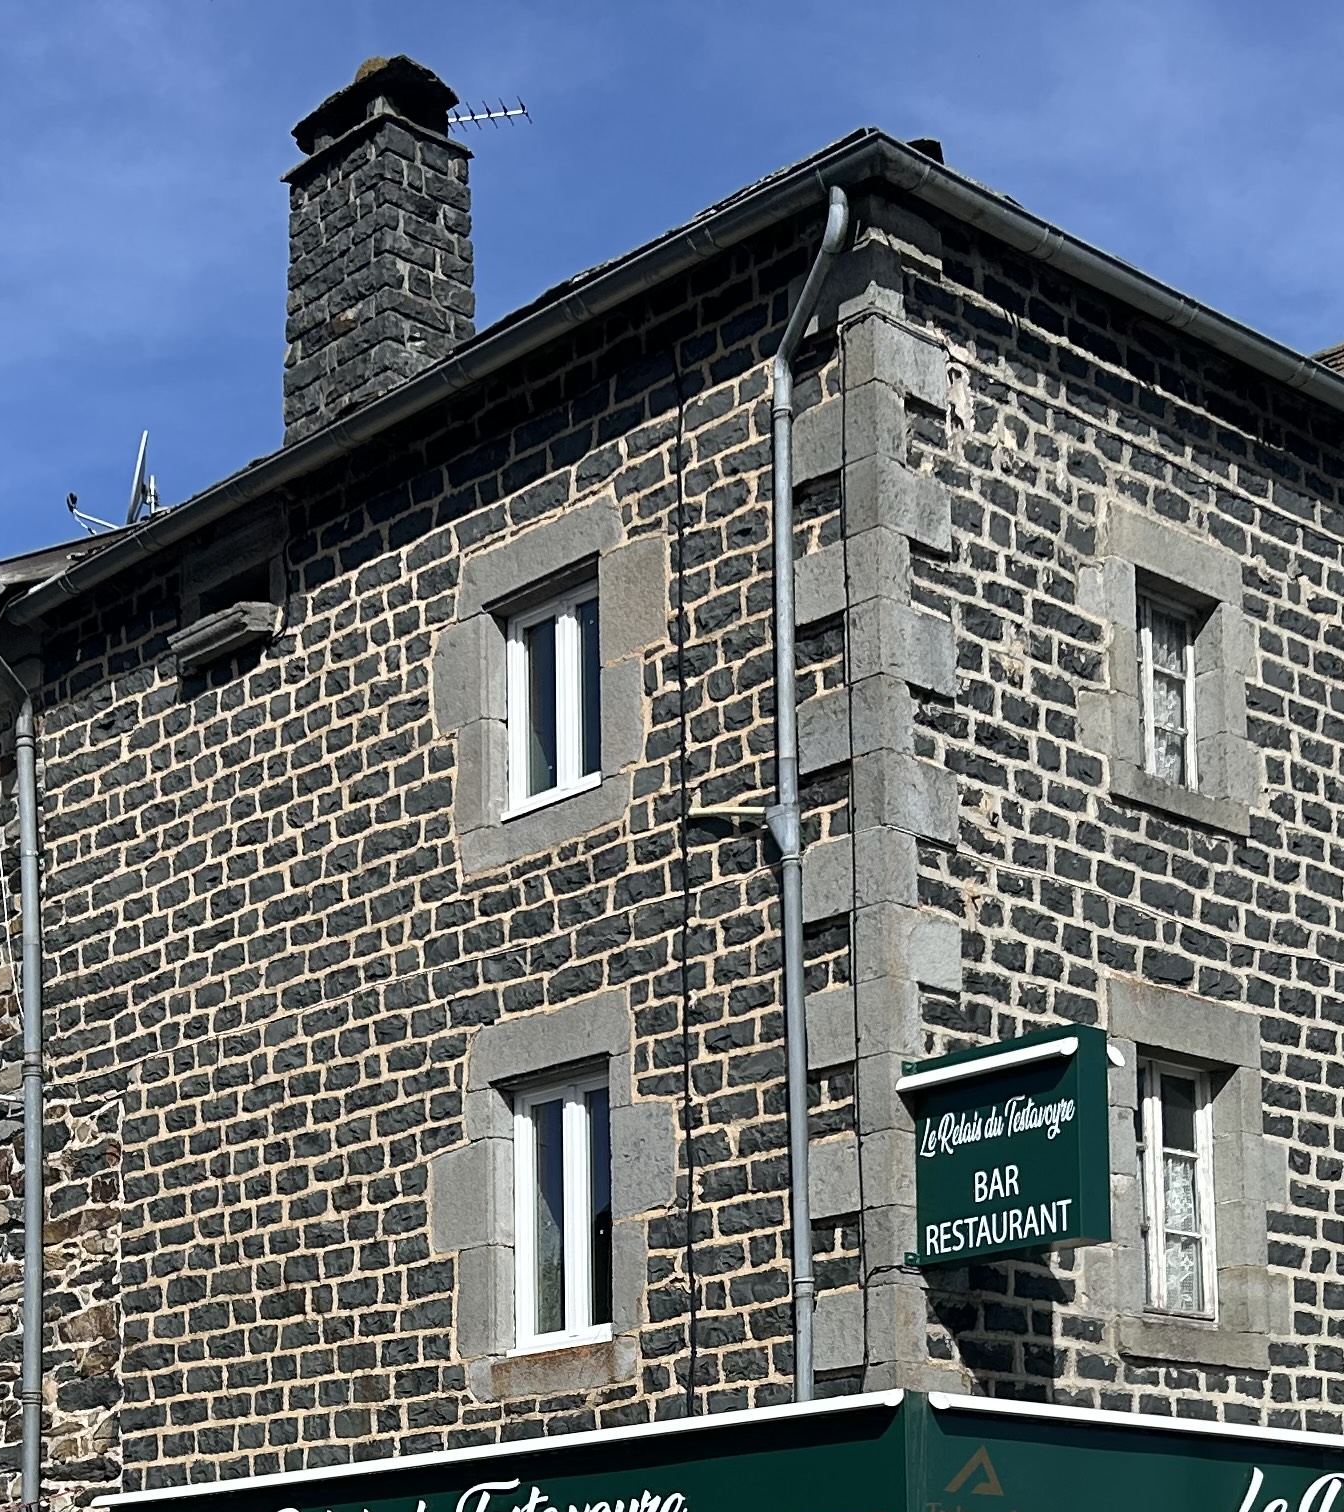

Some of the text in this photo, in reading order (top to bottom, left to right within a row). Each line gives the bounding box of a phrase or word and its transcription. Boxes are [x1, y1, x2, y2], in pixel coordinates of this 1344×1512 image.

[919, 1095, 1076, 1158] Le Relais du Testavoyre
[973, 1164, 1020, 1203] BAR
[925, 1199, 1072, 1256] RESTAURANT
